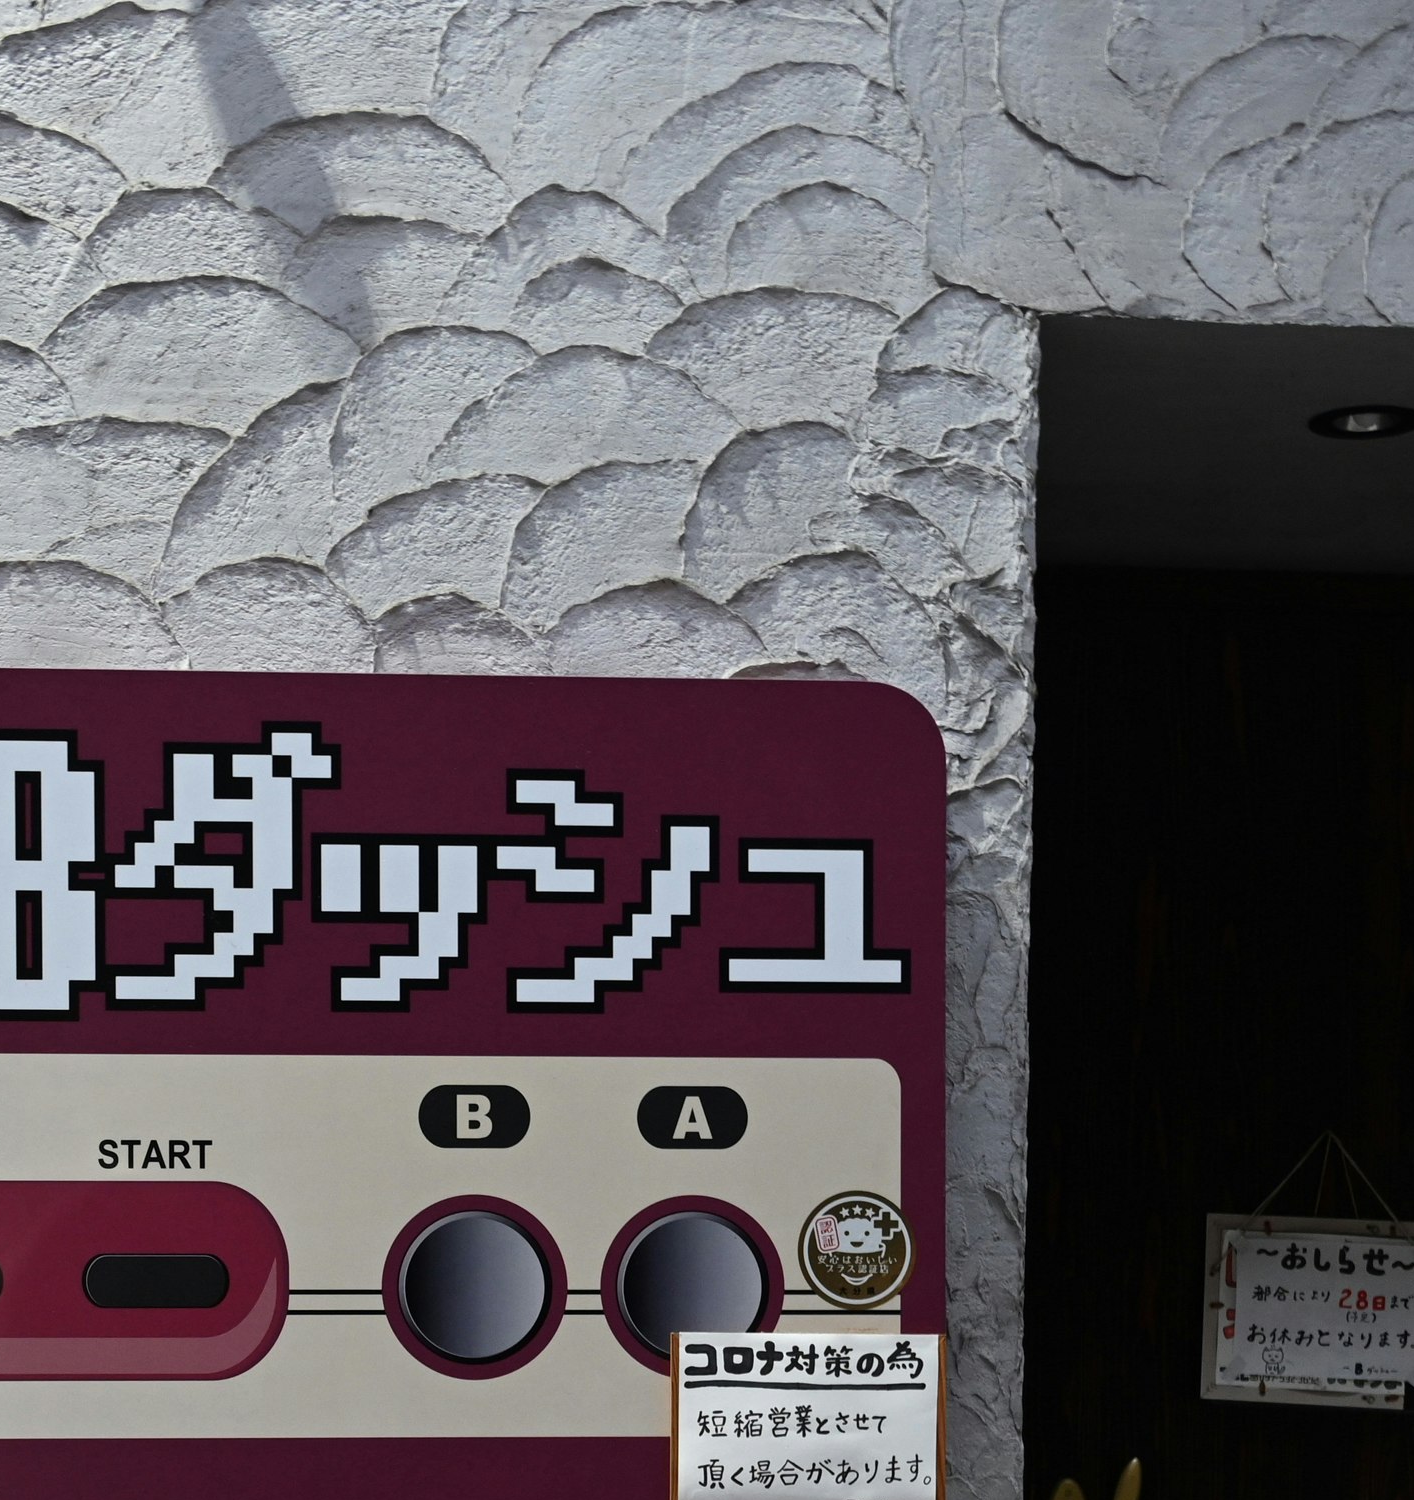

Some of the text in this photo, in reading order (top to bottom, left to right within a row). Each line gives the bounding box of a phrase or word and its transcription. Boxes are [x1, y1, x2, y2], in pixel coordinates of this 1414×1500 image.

[456, 1094, 493, 1140] B
[672, 1096, 713, 1141] A
[97, 1139, 213, 1171] START
[817, 1255, 898, 1265] 安心はおいしい
[684, 1340, 924, 1378] コロナ対策の為
[697, 1405, 887, 1438] 短縮営業とさせて
[698, 1454, 932, 1489] 頂く場合があります。
